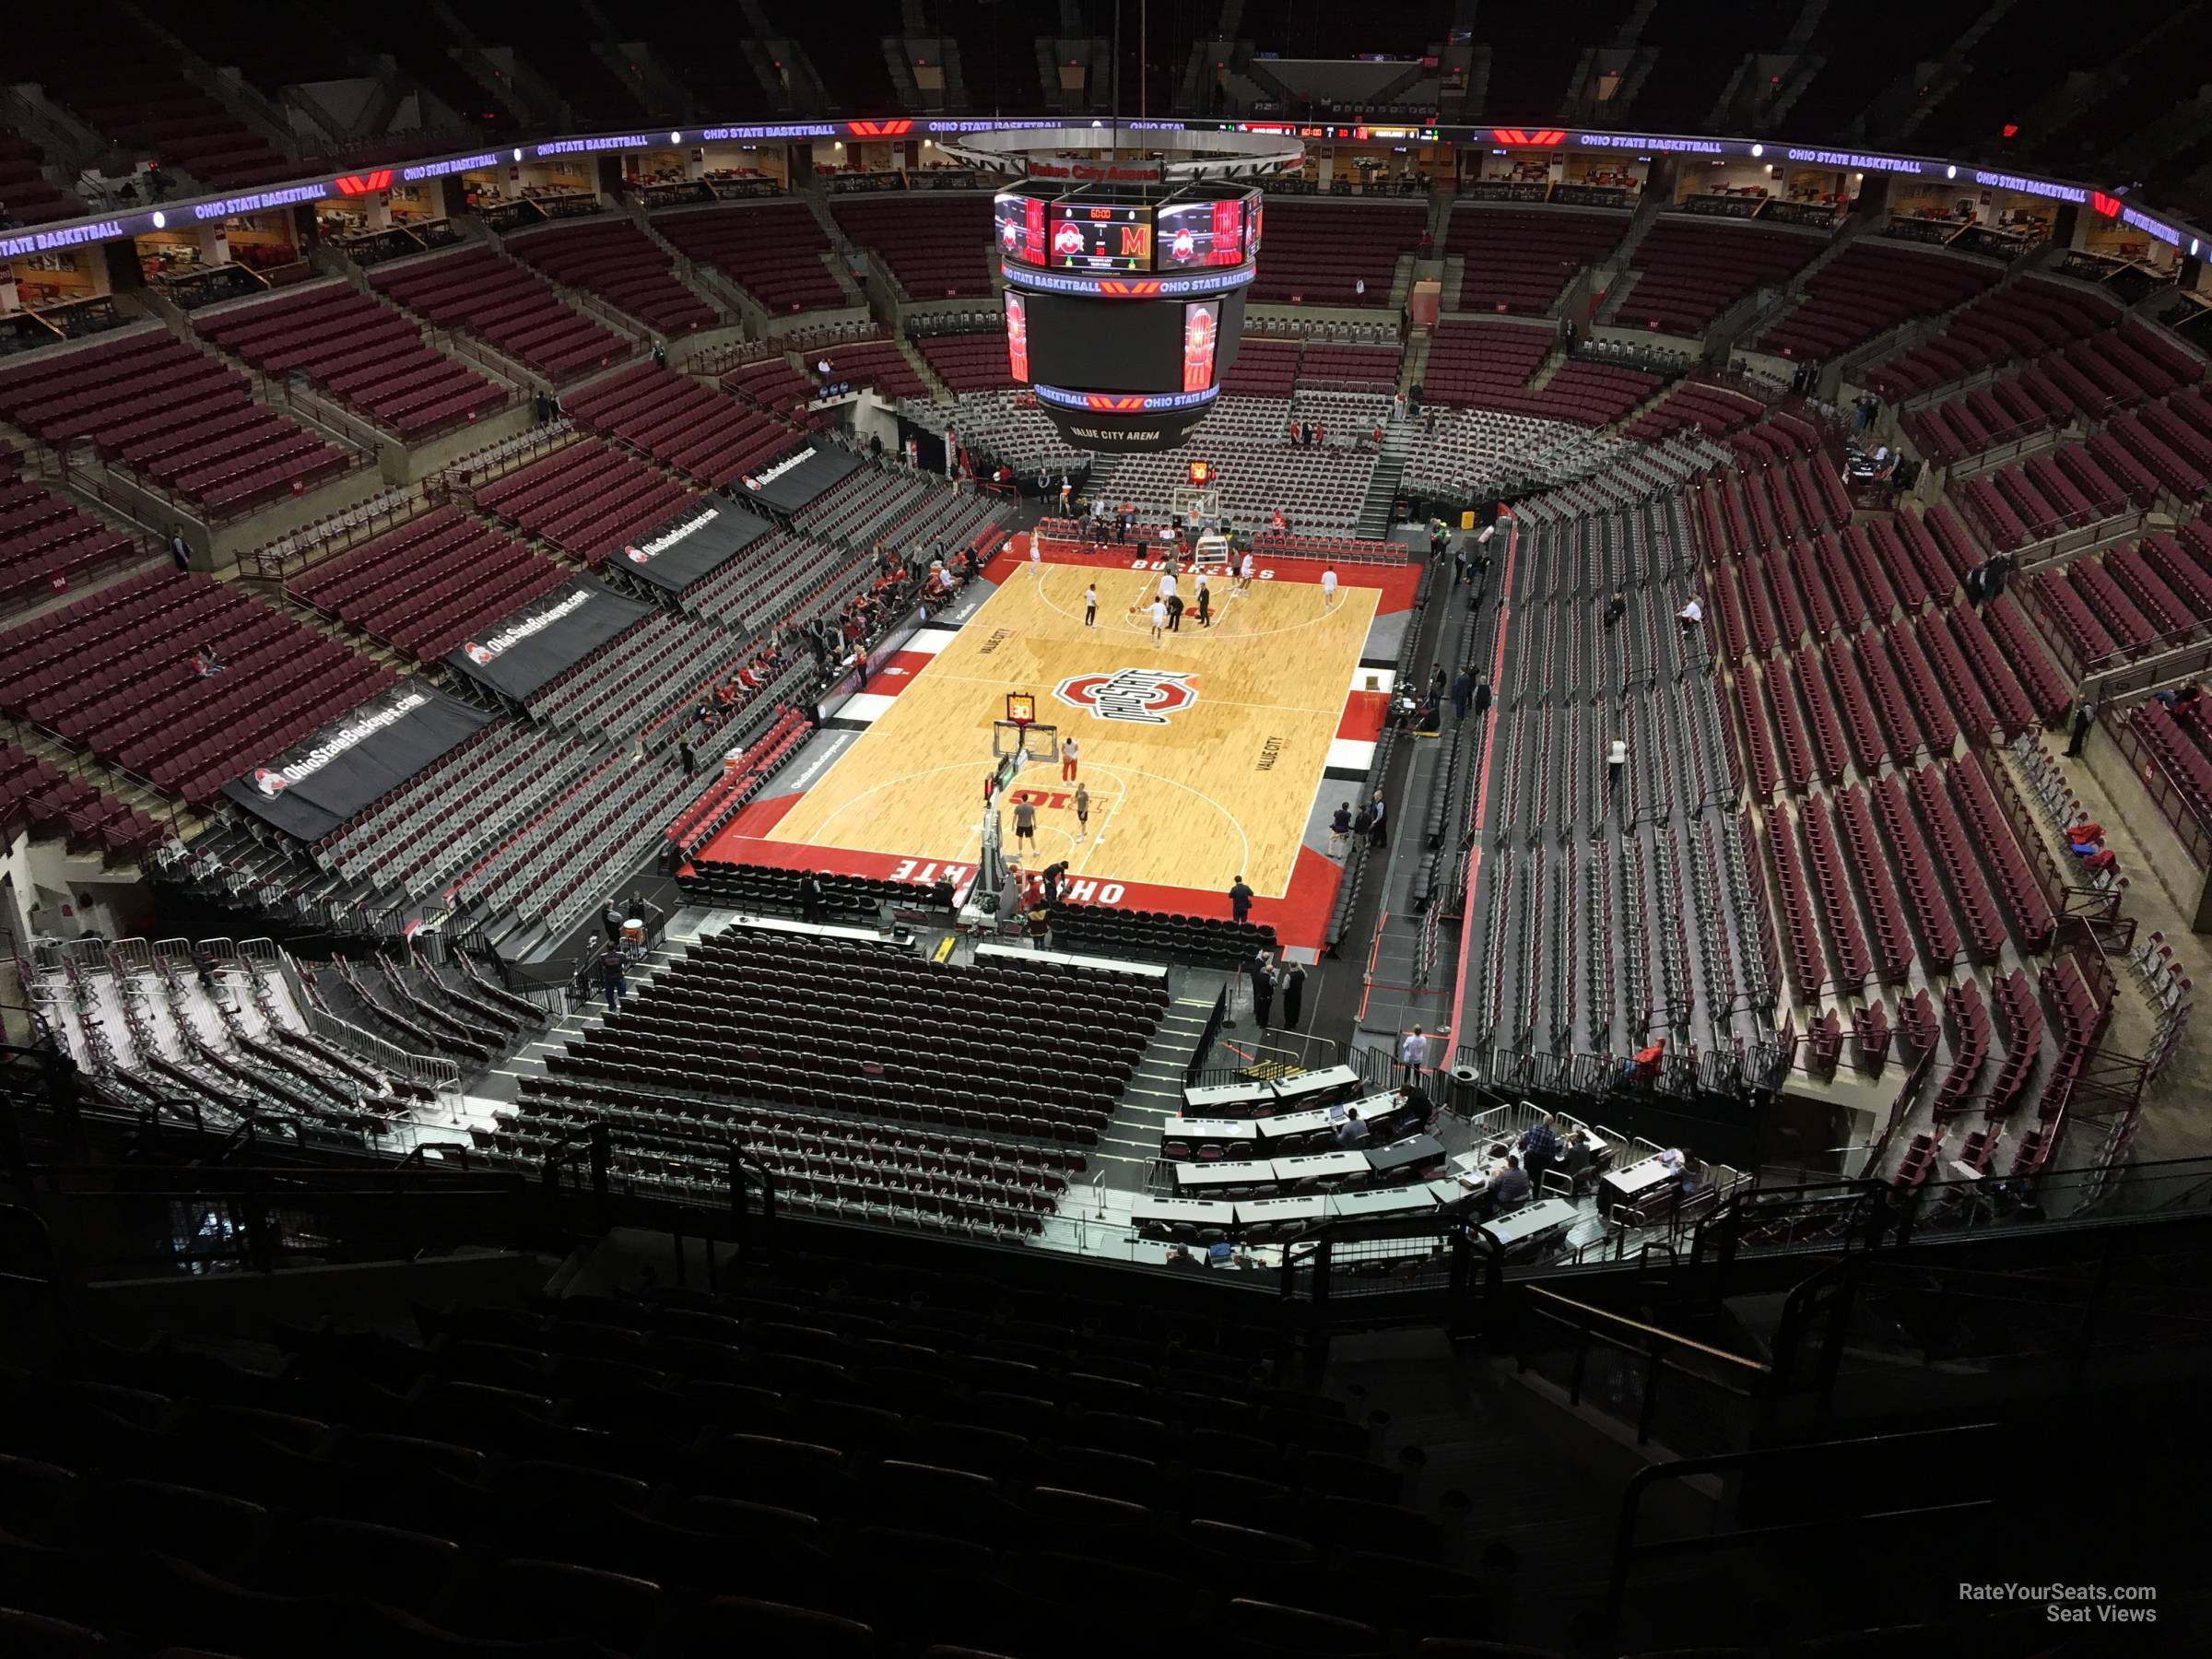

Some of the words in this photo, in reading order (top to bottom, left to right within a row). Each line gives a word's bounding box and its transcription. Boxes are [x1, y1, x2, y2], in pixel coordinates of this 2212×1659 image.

[703, 129, 728, 140] OHIO
[730, 127, 764, 138] STATE
[766, 124, 836, 136] BASKETBALL
[928, 122, 958, 132] OHIO
[959, 122, 993, 131] STATE
[537, 144, 554, 157] OHIO
[555, 141, 584, 154] STATE
[586, 135, 648, 150] BASKETBALL
[1582, 135, 1610, 146] OHIO
[1612, 137, 1646, 148] STATE
[1648, 140, 1722, 153] BASKETBALL
[404, 166, 426, 181] OHIO
[426, 162, 451, 177] STATE
[451, 154, 498, 173] BASKETBALL
[1789, 148, 1815, 161] OHIO
[1817, 152, 1849, 165] STATE
[1851, 155, 1922, 173] BASKETBALL
[1029, 161, 1070, 179] Value
[1072, 164, 1105, 182] City
[1106, 165, 1159, 181] Arena
[1976, 171, 1999, 185] OHIO
[1999, 176, 2026, 191] STATE
[2027, 181, 2086, 203] BASKETBALL
[195, 202, 226, 219] OHIO
[227, 195, 260, 214] STATE
[262, 183, 326, 207] BASKETBALL
[1091, 209, 1111, 218] 60:00
[0, 237, 35, 257] TATE
[37, 221, 123, 250] BASKETBALL
[1121, 227, 1147, 255] M
[1014, 271, 1033, 285] STATE
[1035, 276, 1101, 292] BASKETBALL
[1160, 281, 1190, 292] OHIO
[1192, 277, 1220, 290] STATE
[1144, 397, 1172, 407] OHIO
[1174, 393, 1200, 406] STATE
[1070, 426, 1099, 438] VALUE
[1100, 430, 1124, 440] CITY
[1126, 430, 1159, 441] ARENA
[642, 509, 719, 555] OhioStateBuckeyes.com
[53, 577, 65, 588] 104
[488, 591, 588, 652] OhioStateBuckeyes.com
[283, 693, 424, 780] OhioStateBuckeyes.com
[1264, 735, 1283, 751] CITY
[1255, 751, 1277, 771] VALUE
